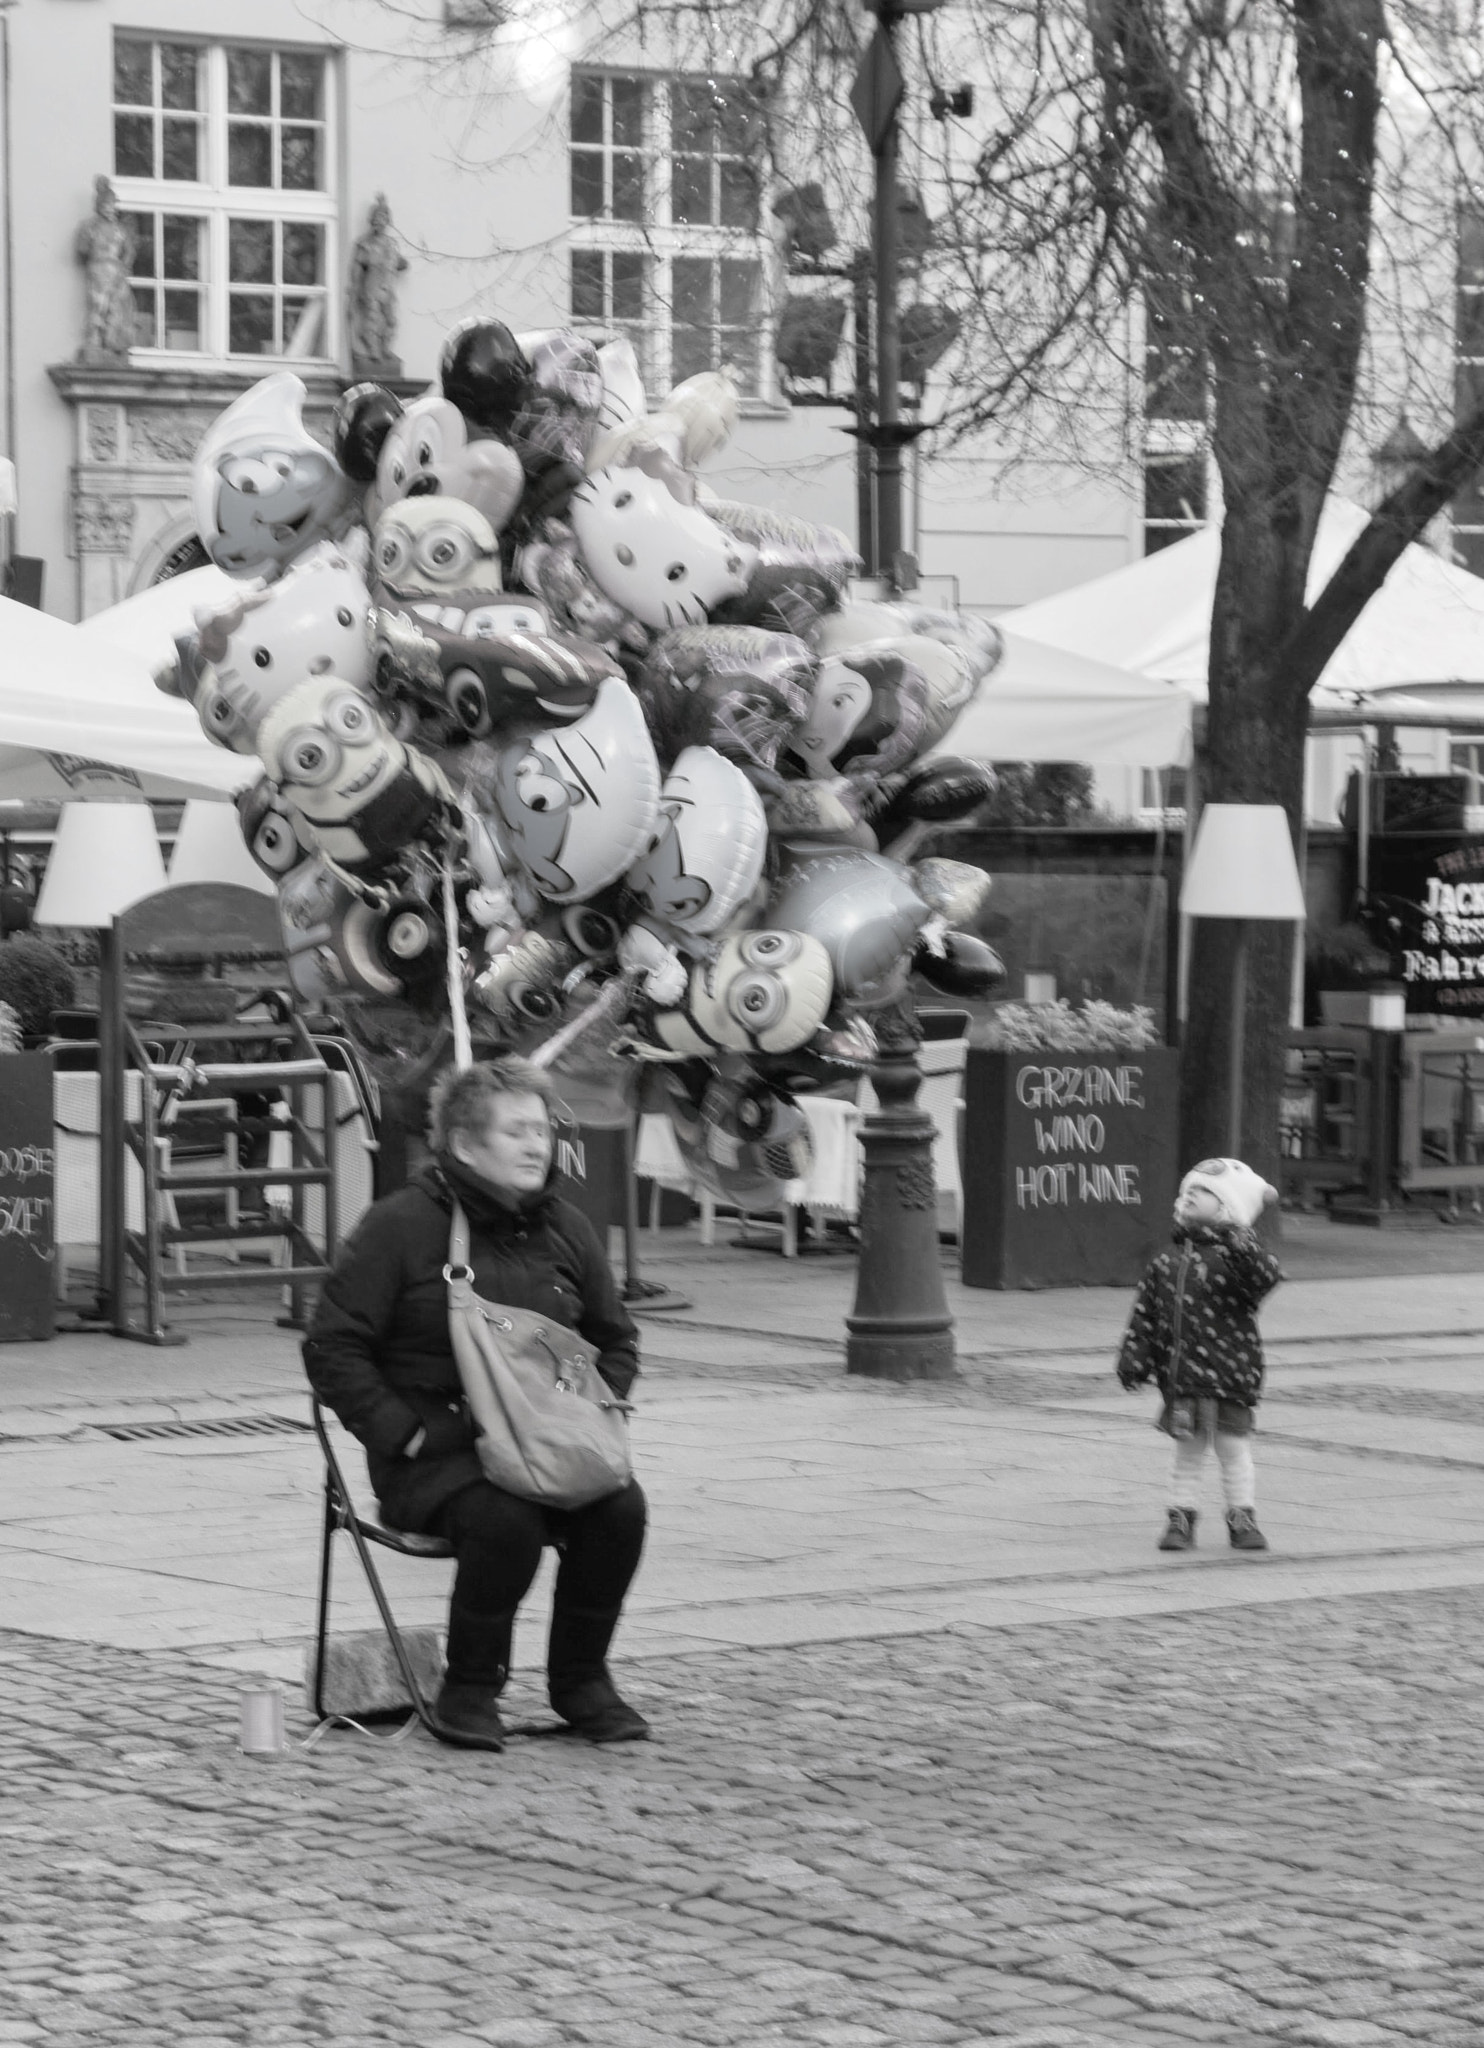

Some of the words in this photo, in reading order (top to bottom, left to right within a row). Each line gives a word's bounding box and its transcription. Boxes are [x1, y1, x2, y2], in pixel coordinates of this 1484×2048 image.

[1016, 1065, 1145, 1109] GRZANE
[1034, 1114, 1105, 1154] WINO
[1016, 1162, 1076, 1210] HOT
[1078, 1162, 1142, 1206] WINE
